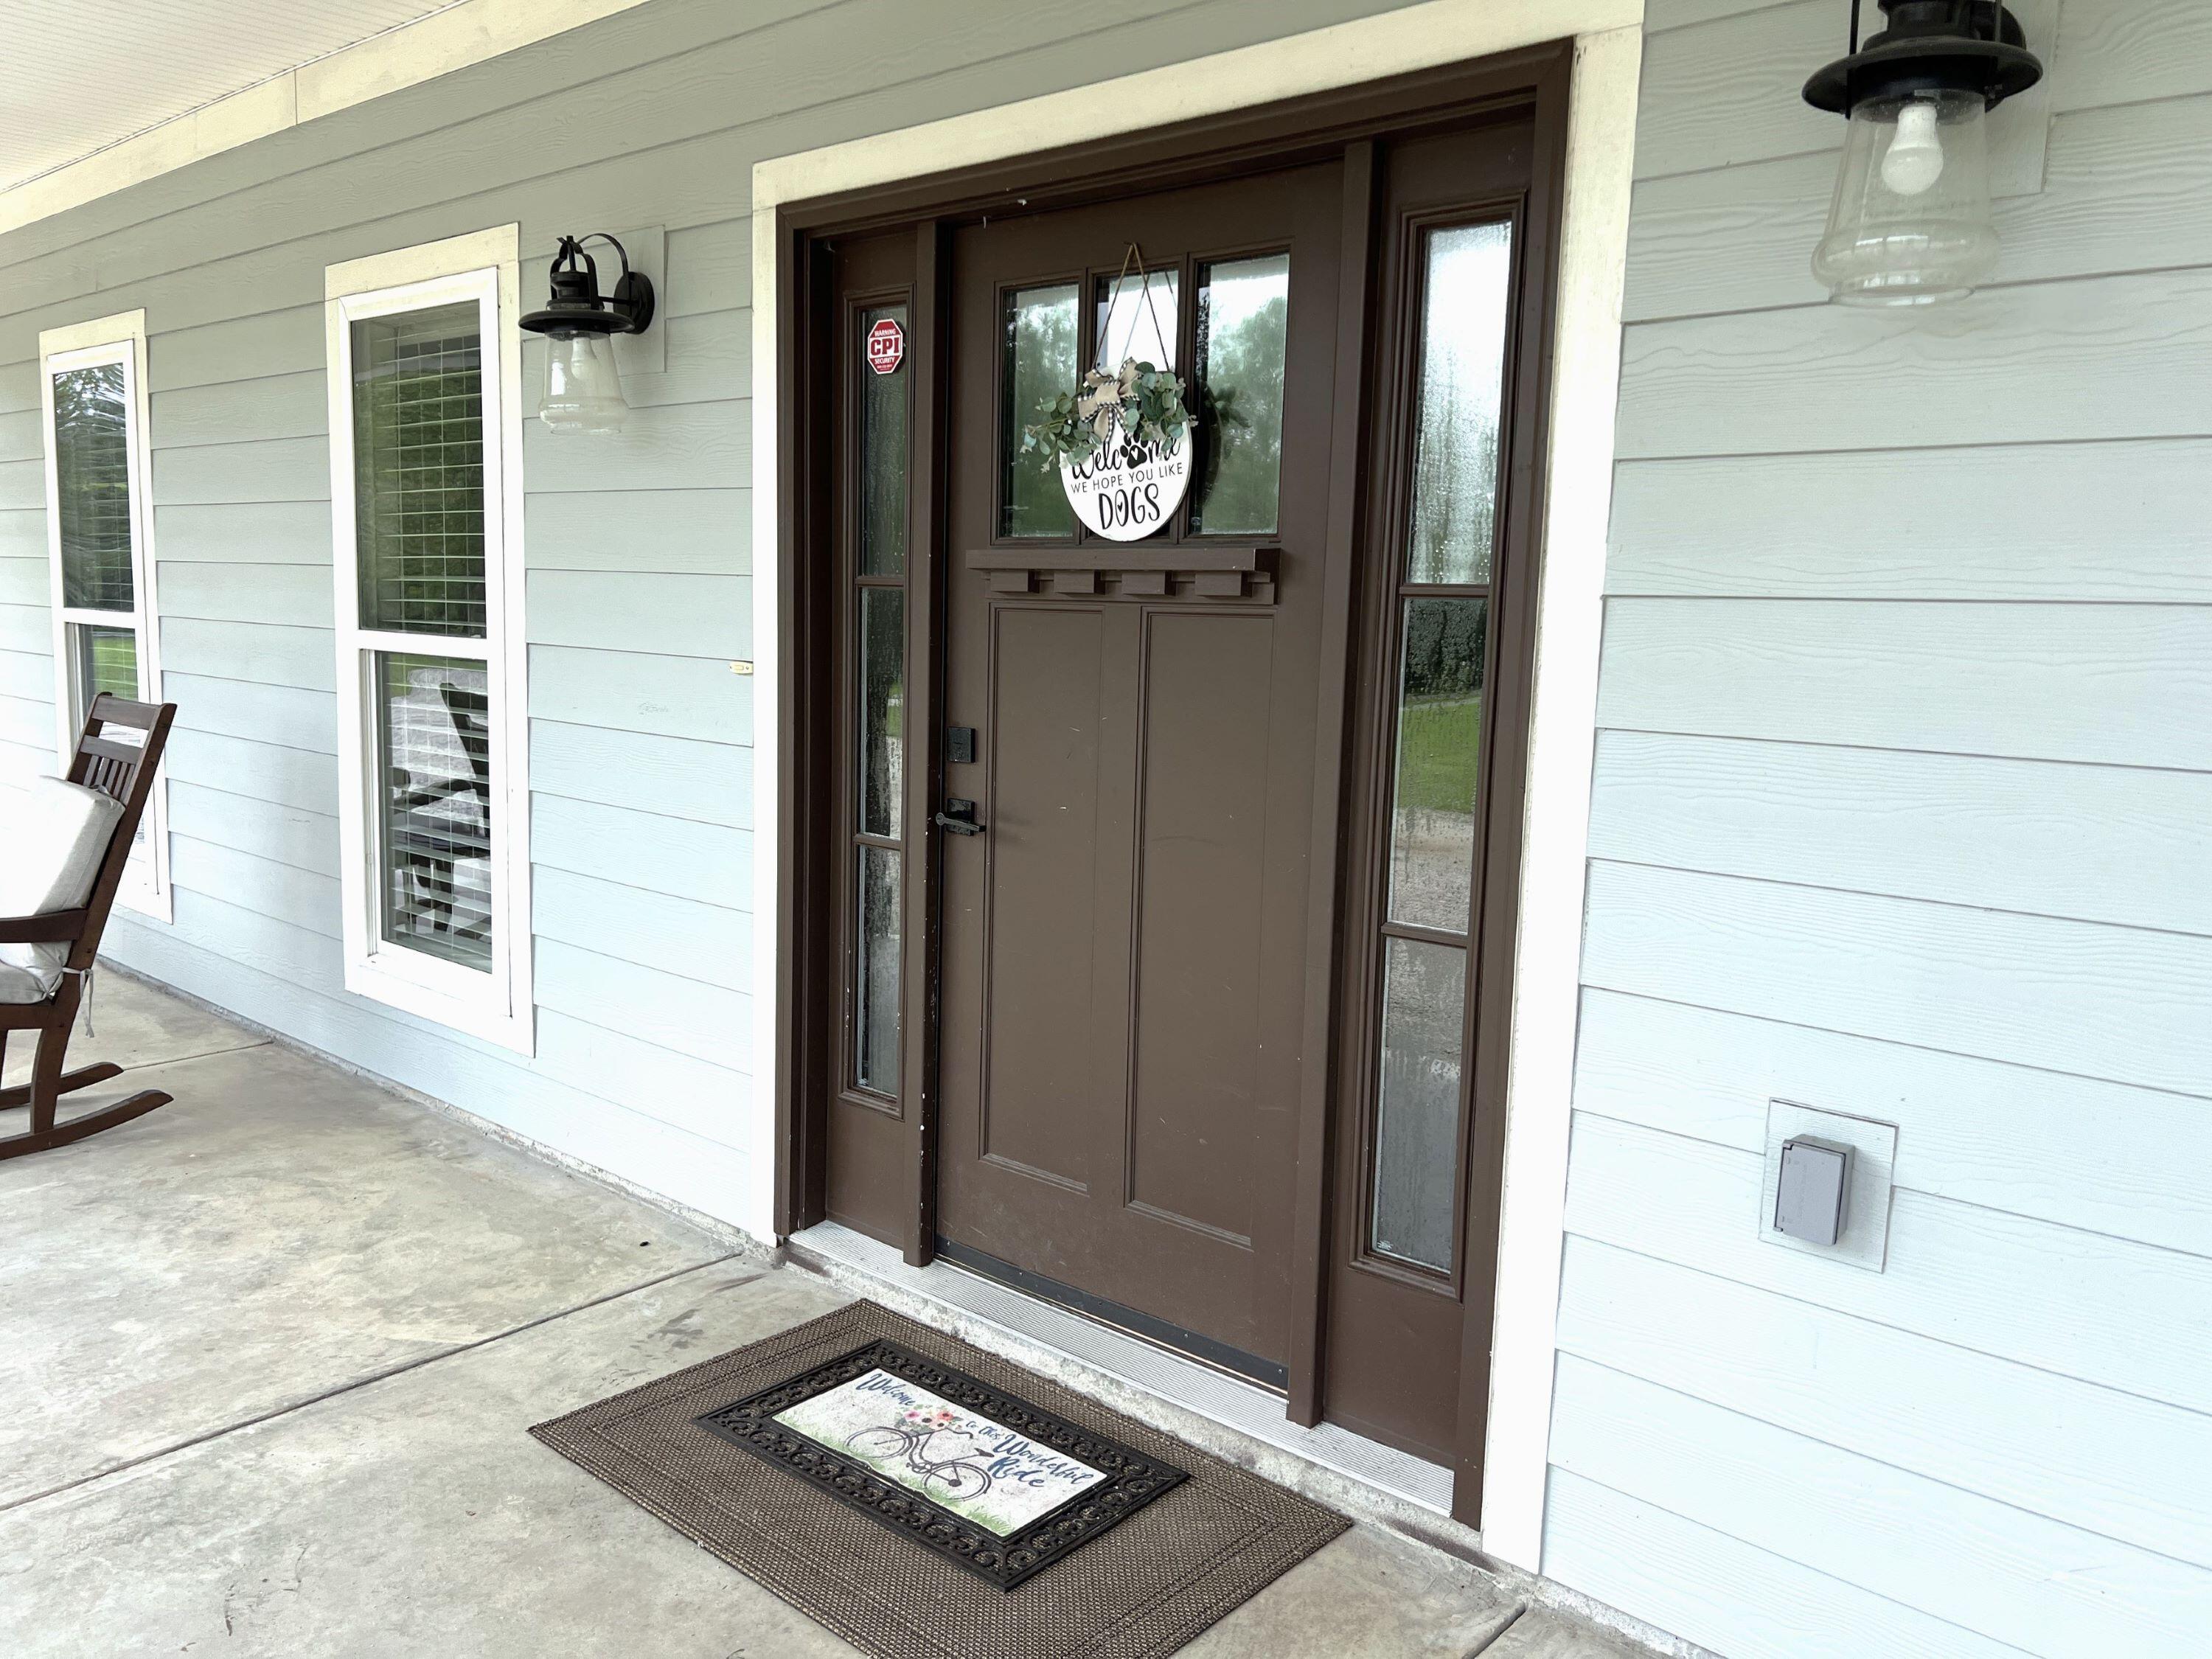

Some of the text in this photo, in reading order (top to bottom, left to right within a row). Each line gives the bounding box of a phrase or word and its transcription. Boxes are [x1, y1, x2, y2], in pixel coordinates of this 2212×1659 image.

[871, 338, 900, 355] CPI
[874, 329, 896, 337] WARNING
[1071, 462, 1183, 493] WE HOPE YOU LIKE
[1099, 483, 1161, 529] DOGS
[855, 1373, 916, 1406] Welcome
[987, 1456, 1045, 1487] Ride
